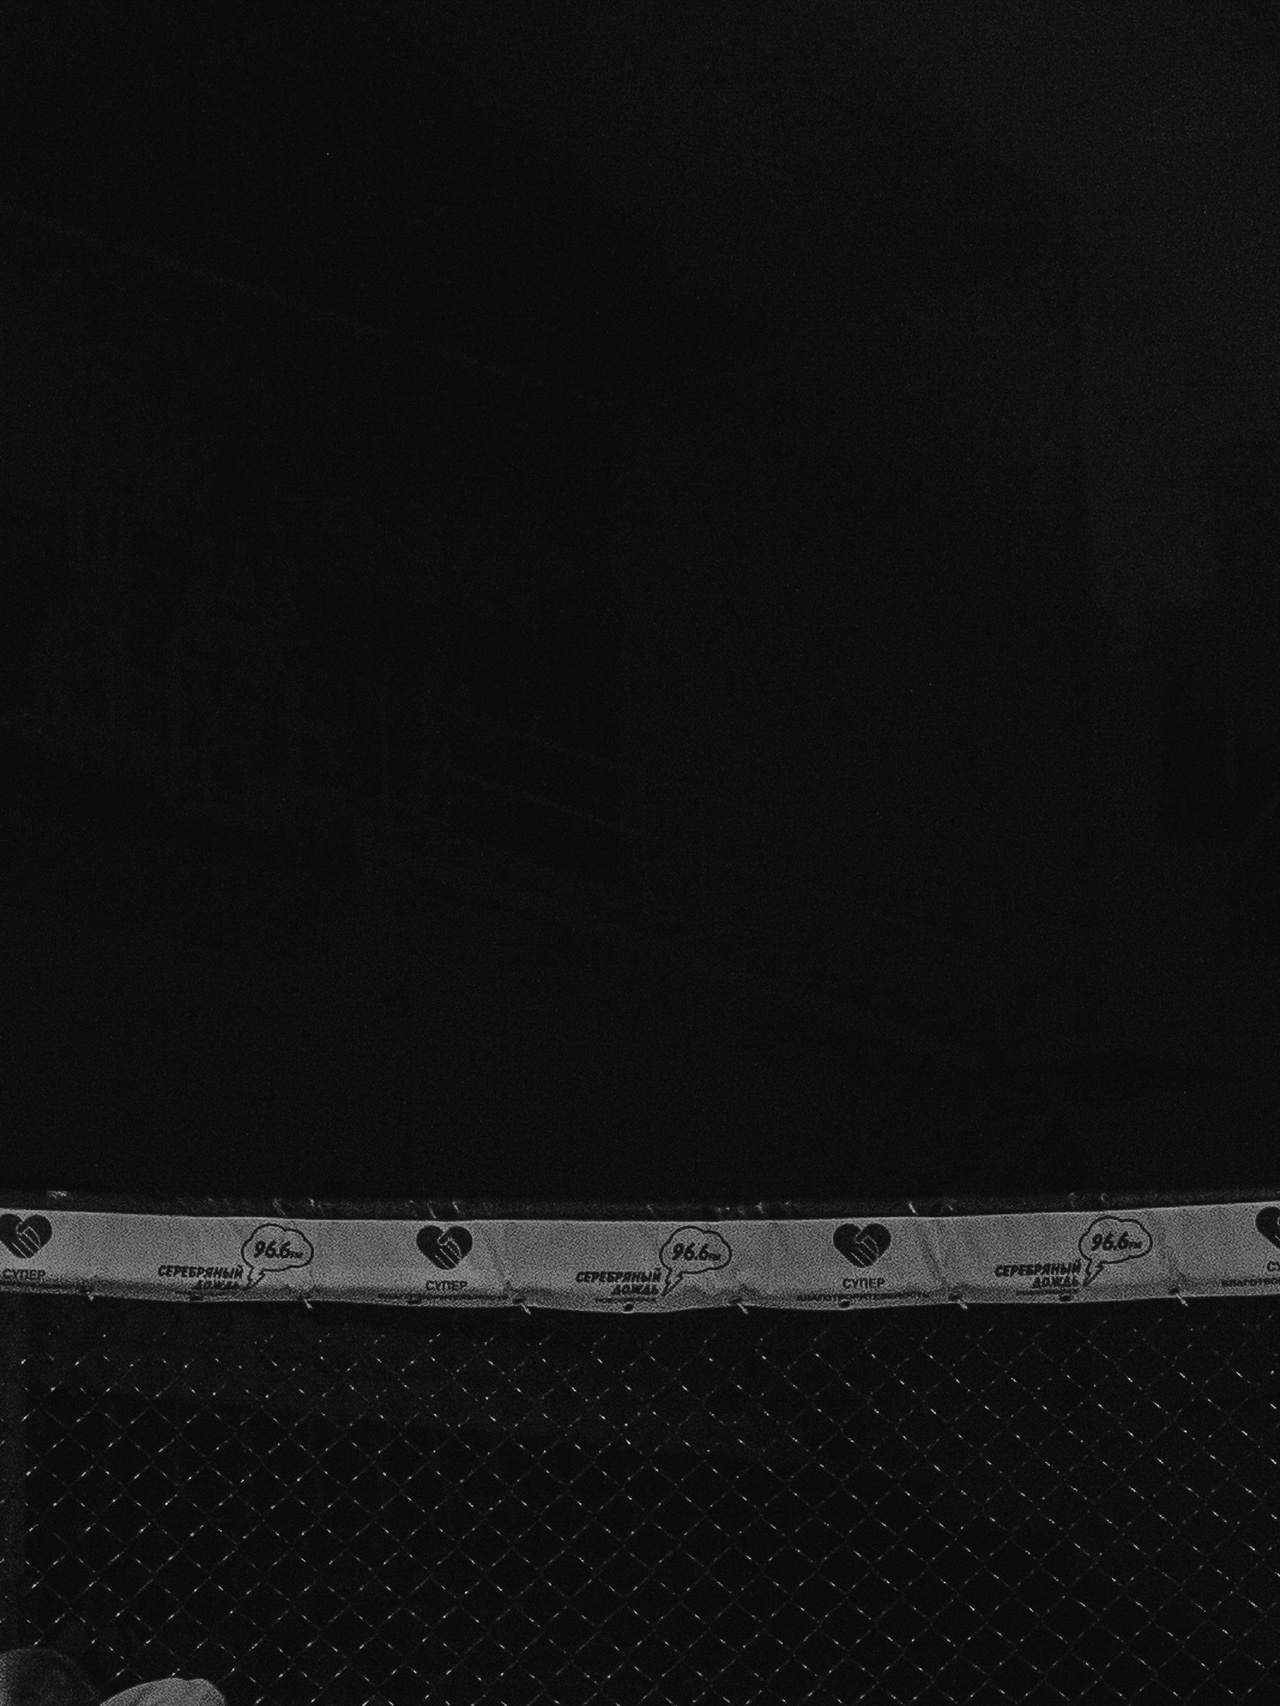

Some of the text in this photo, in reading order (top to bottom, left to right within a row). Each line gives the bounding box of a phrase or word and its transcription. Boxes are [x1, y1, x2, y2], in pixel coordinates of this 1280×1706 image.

[158, 1264, 244, 1279] СЕРЕБРЯНЫЙ
[994, 1258, 1081, 1277] СЕРЕБРЯНЫЙ
[2, 1268, 46, 1281] СУПЕР
[575, 1267, 662, 1283] СЕРЕБРЯНЫЙ
[425, 1279, 468, 1291] СУПЕР
[842, 1277, 885, 1289] СУПЕР
[1032, 1277, 1081, 1289] ДОЖДЬ
[611, 1284, 659, 1296] ДОЖДЬ
